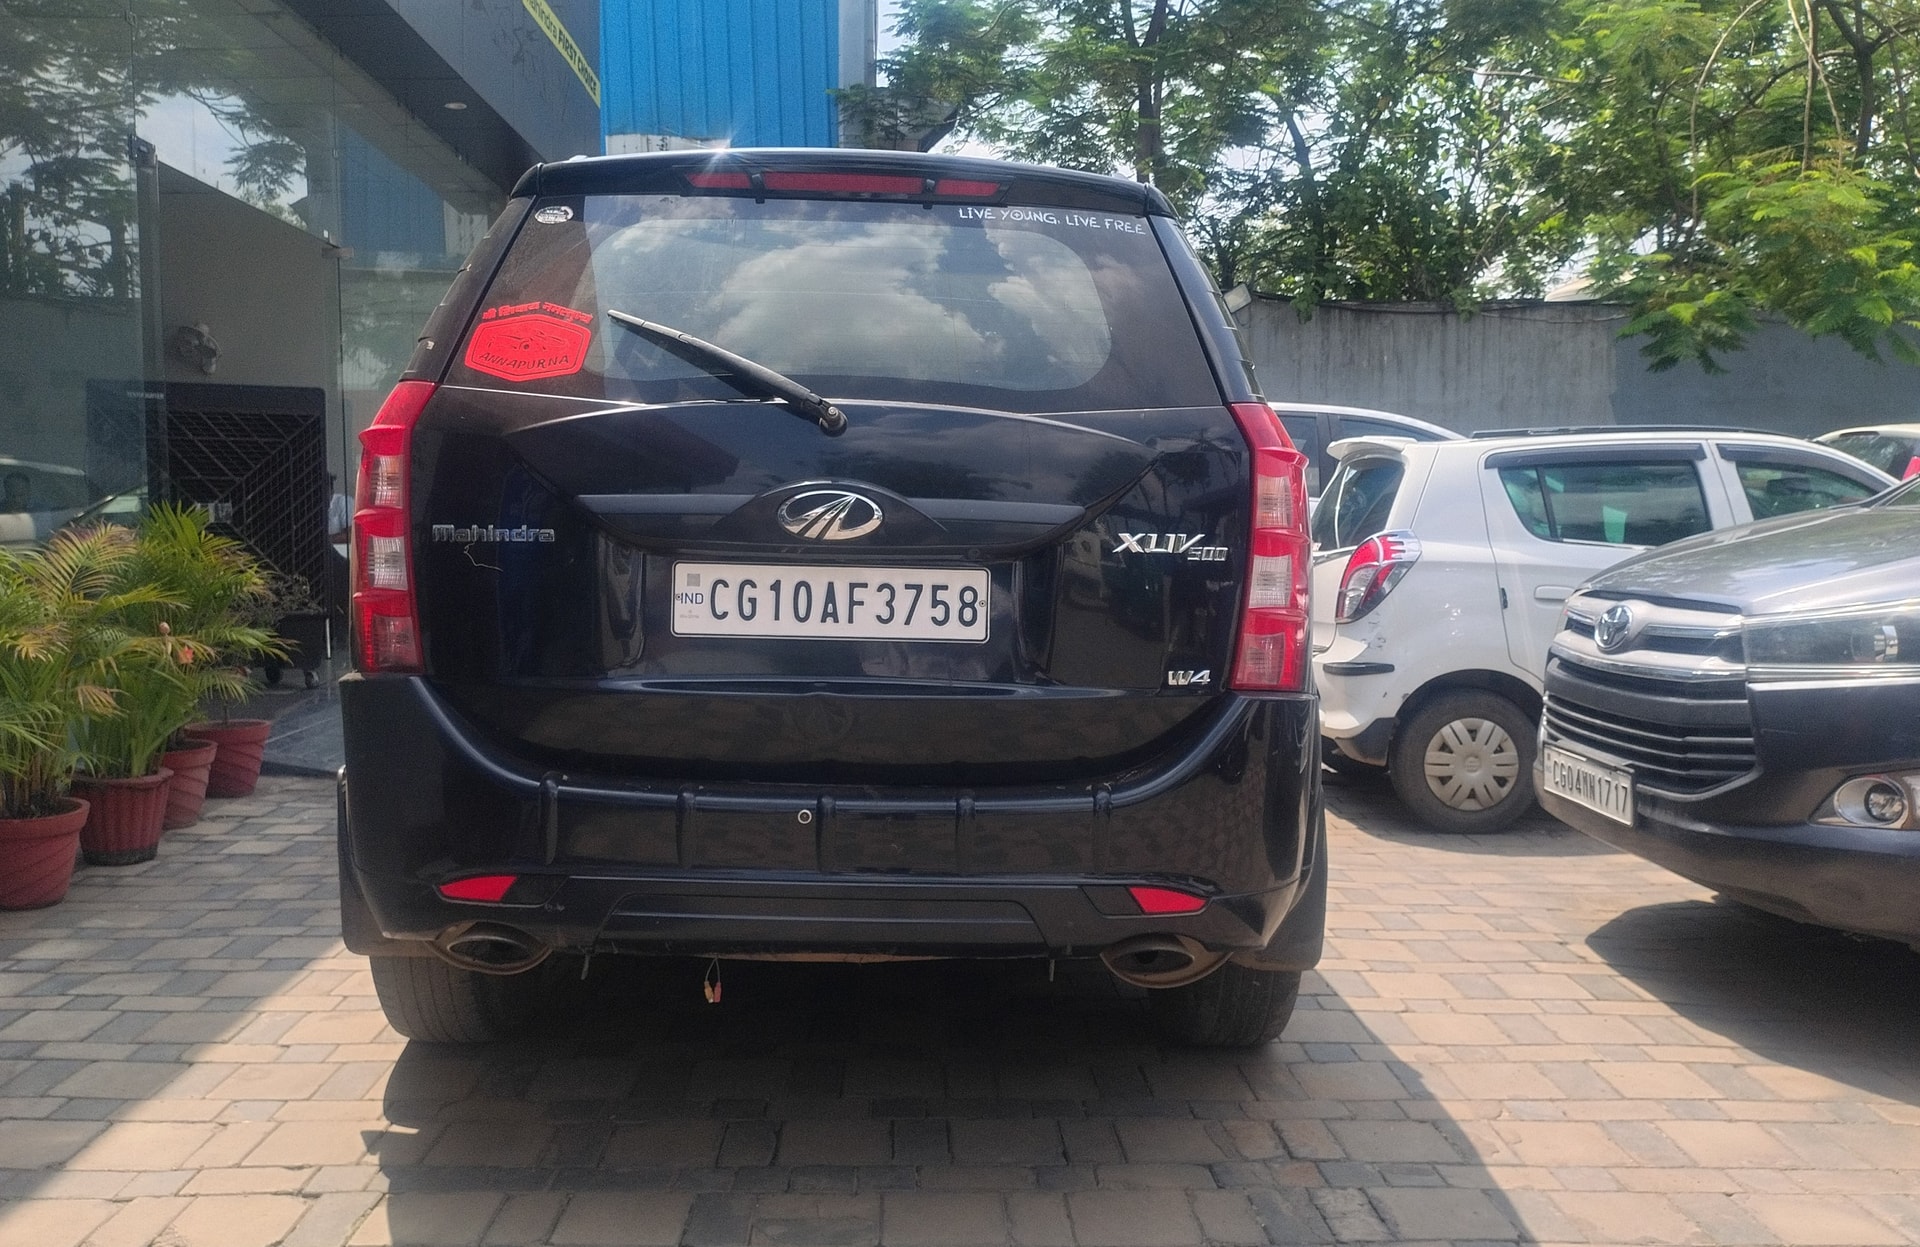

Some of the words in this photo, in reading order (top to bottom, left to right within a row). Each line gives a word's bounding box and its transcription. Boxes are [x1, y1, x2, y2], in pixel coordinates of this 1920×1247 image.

[558, 27, 577, 65] FIRST
[958, 207, 996, 220] LIVE
[1066, 214, 1101, 229] LIVE
[1104, 218, 1146, 236] FREE
[479, 352, 569, 369] ANNAPURNA
[432, 524, 556, 543] Mahindra
[681, 592, 704, 605] IND
[709, 578, 980, 628] CG10AF3758
[1167, 669, 1212, 687] W4
